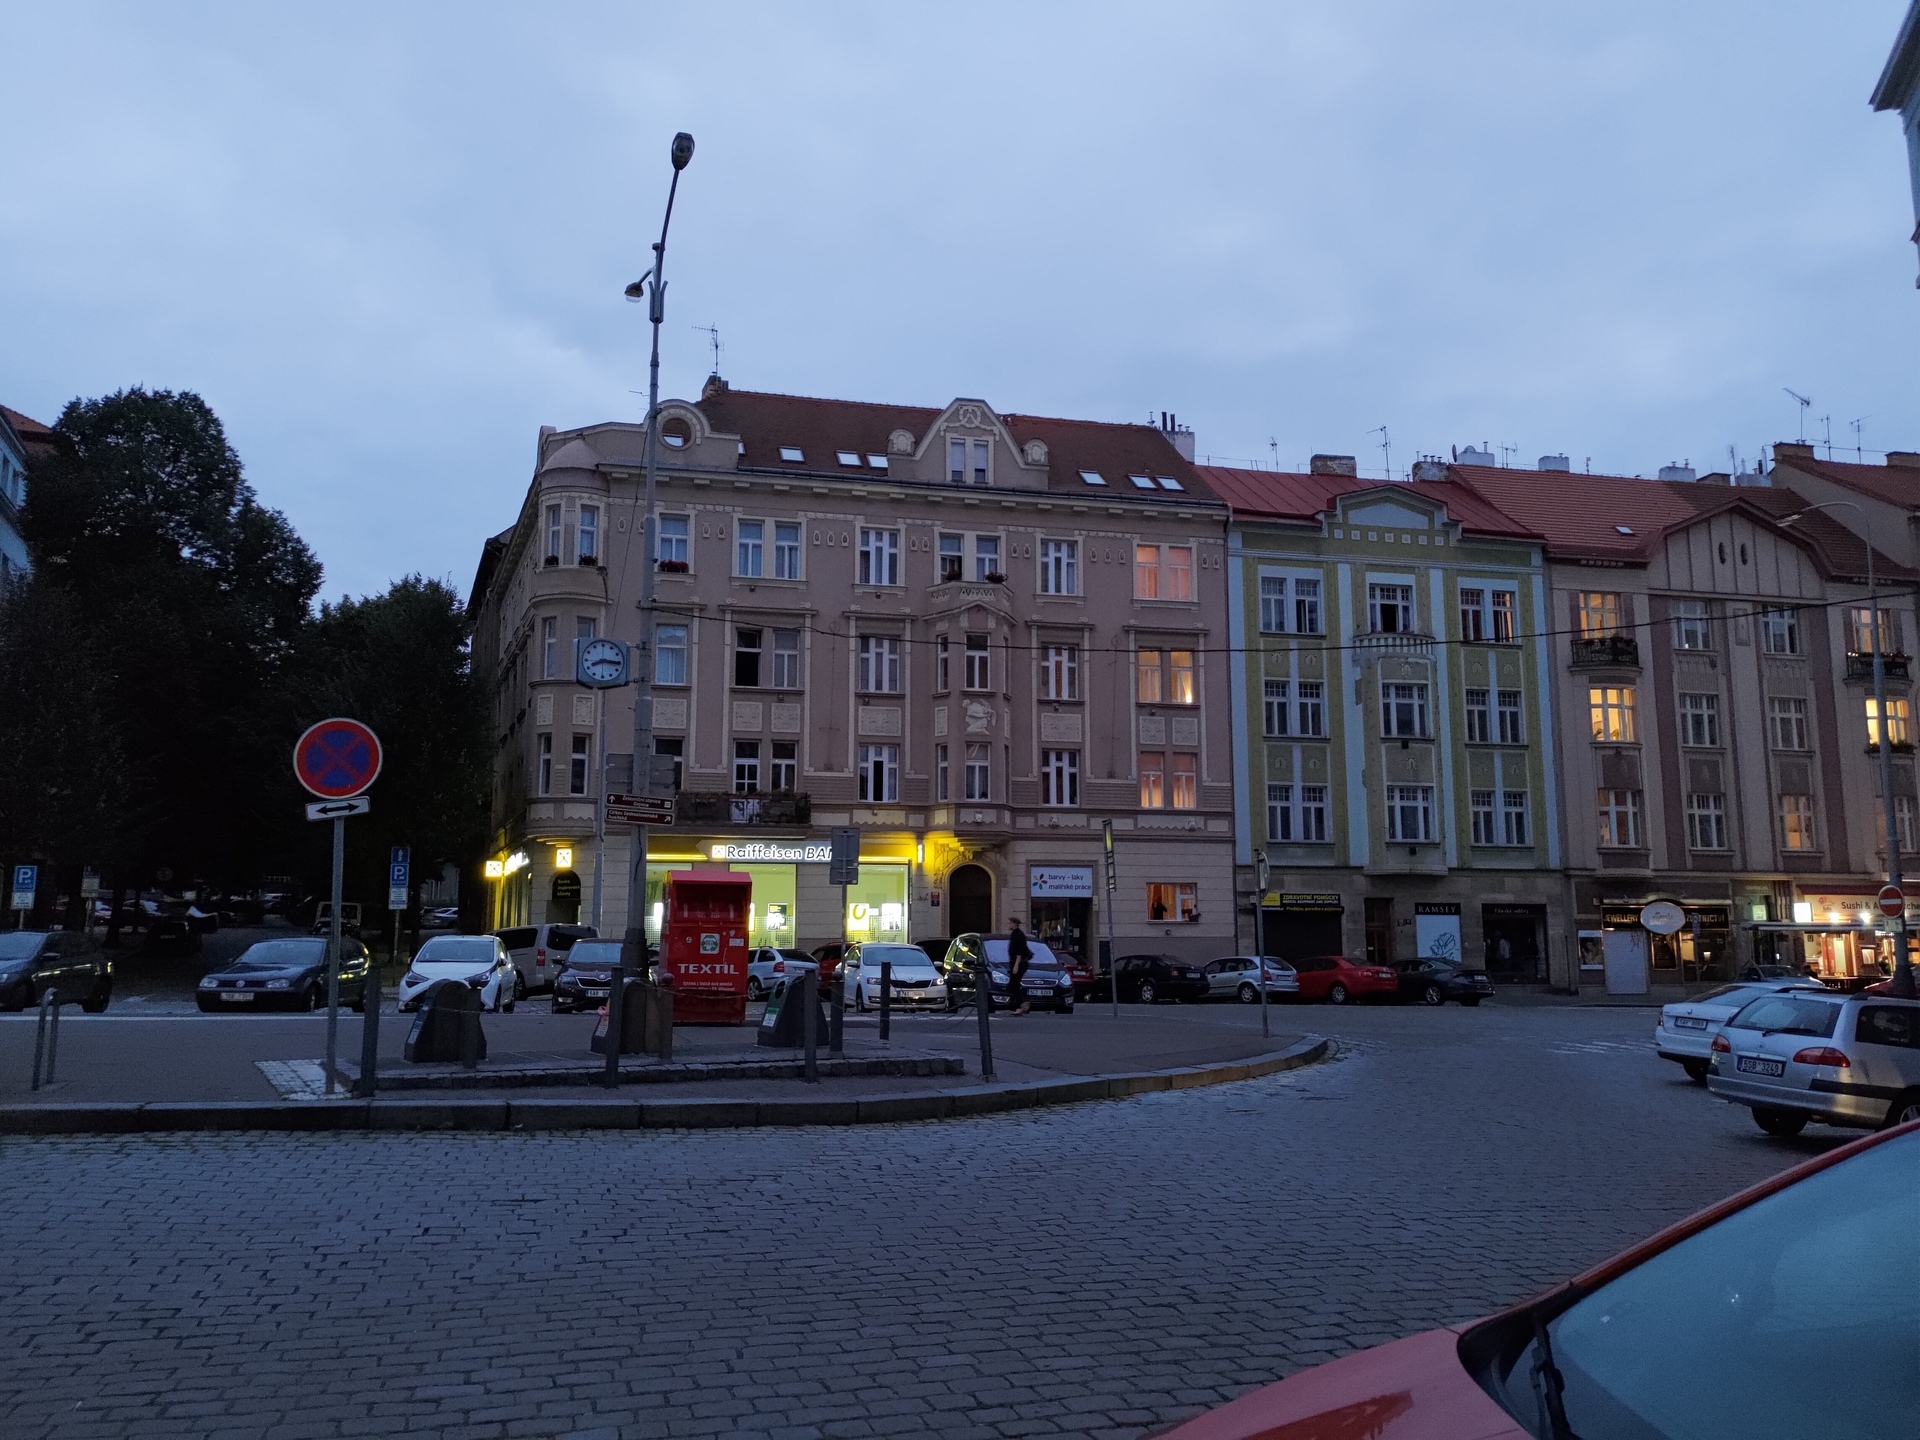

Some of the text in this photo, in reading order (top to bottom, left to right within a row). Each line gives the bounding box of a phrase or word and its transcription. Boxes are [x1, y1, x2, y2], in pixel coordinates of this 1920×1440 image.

[727, 844, 802, 859] Raiffeisen
[1418, 905, 1457, 913] RAMSEY
[1841, 901, 1863, 910] Sushi
[1864, 902, 1870, 910] &
[1603, 913, 1639, 922] JEWELLERY
[677, 963, 740, 975] TEXTIL
[1743, 1059, 1779, 1073] 5SB 3249
